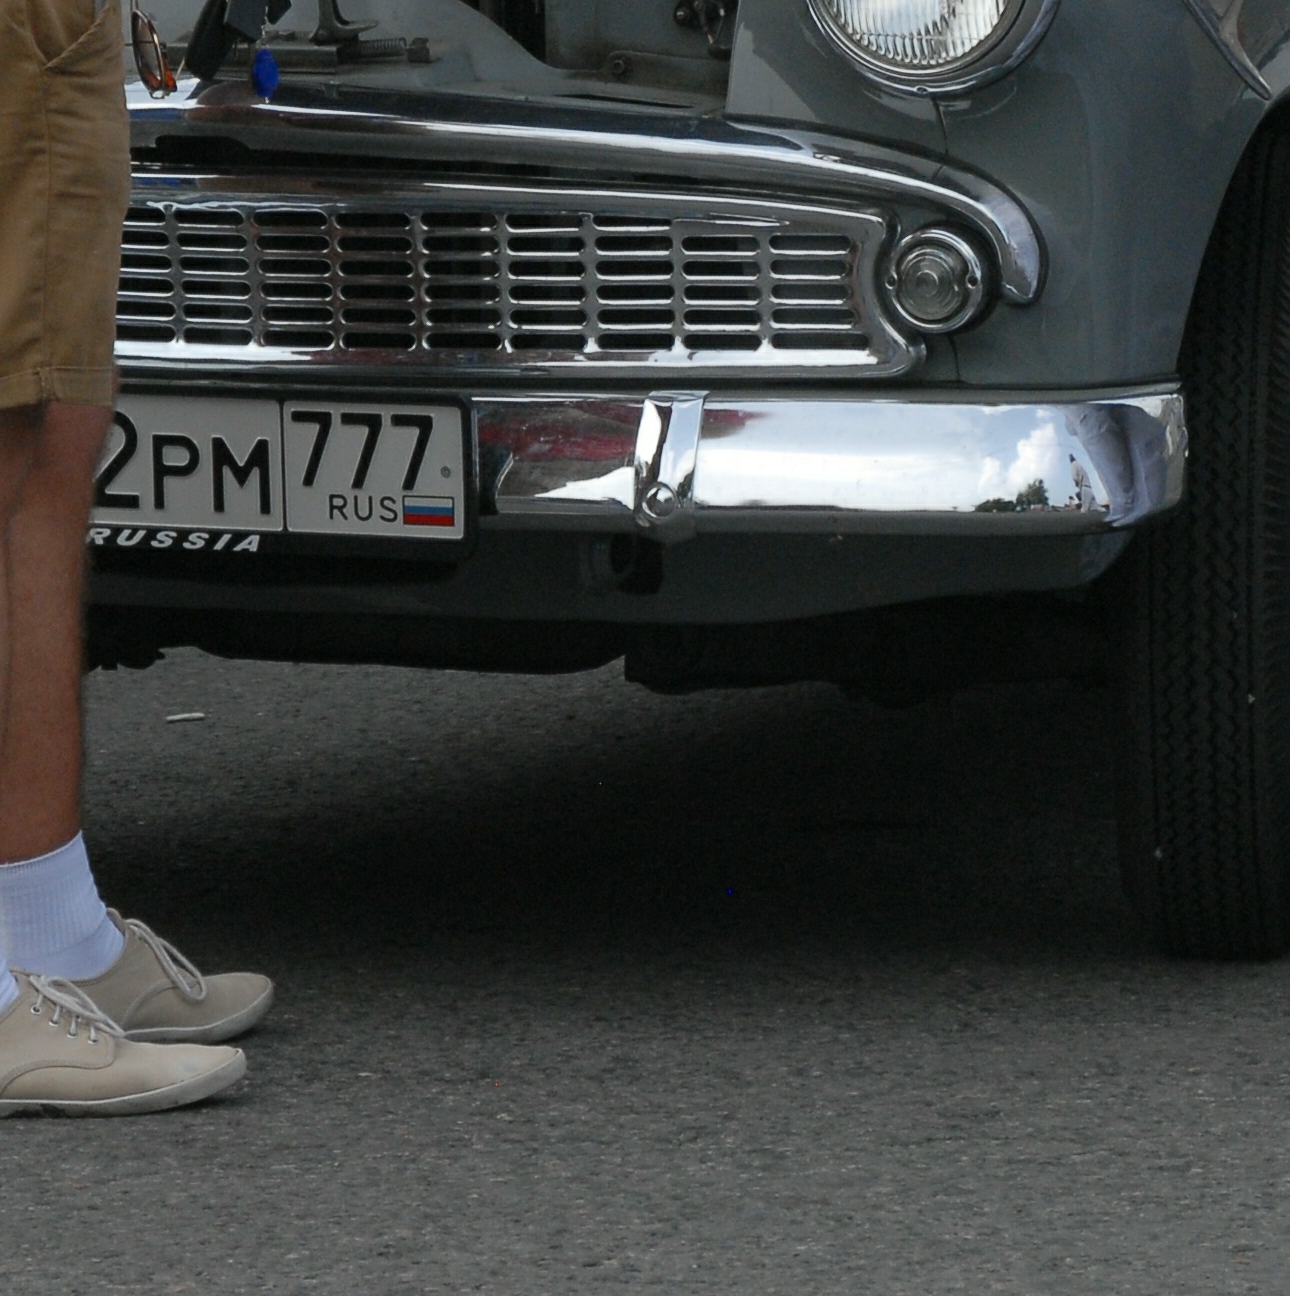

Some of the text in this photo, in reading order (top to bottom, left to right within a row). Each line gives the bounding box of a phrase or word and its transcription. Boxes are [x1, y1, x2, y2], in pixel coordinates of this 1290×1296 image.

[291, 410, 434, 492] 777
[329, 493, 399, 524] RUS
[85, 528, 261, 553] RUSSIA
